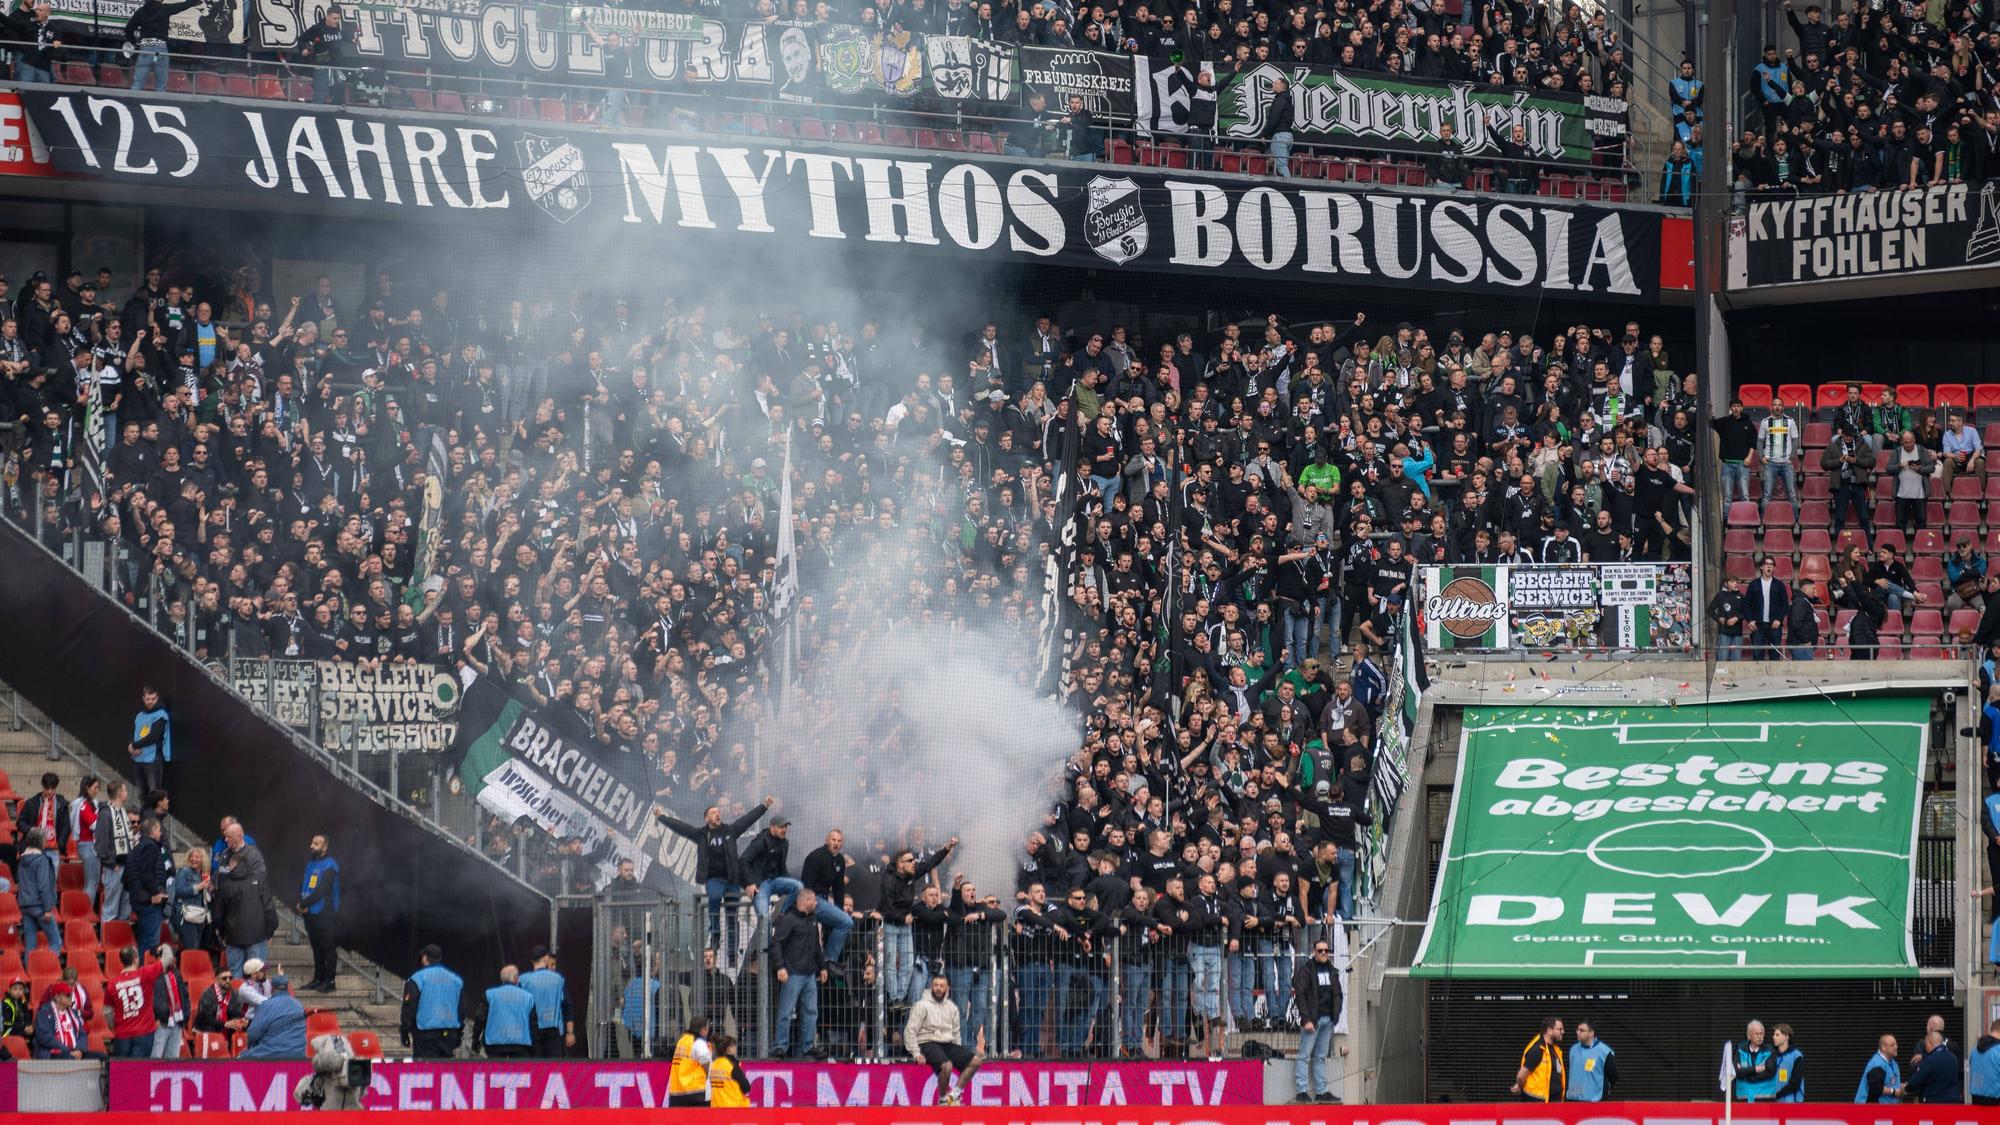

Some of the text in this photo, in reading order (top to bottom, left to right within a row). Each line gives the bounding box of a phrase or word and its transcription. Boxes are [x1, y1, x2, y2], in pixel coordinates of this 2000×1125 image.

[579, 6, 693, 31] TADIONVERBOT
[1023, 69, 1131, 93] FREUNDESKREIS
[1594, 118, 1618, 137] CREW
[526, 148, 581, 196] Borussia
[50, 96, 1643, 296] 125 JAHRE MYTHOS BORUSSIA
[1090, 204, 1135, 237] Borussia
[1749, 183, 1968, 242] KYFFHÄUSER
[1792, 227, 1926, 281] FOHLEN
[1514, 572, 1594, 590] BEGLEIT
[1429, 594, 1507, 621] Ultras
[1514, 590, 1593, 606] SERVICE
[319, 661, 434, 692] BEGLEIT
[320, 691, 437, 721] SERVICE
[510, 717, 643, 831] BRACHELEN
[1495, 755, 1889, 790] Bestens
[499, 767, 568, 826] Willicher
[1489, 789, 1887, 821] abgesichert
[1465, 893, 1882, 930] DEVK
[1513, 934, 1832, 945] Gesagt. Getan. Geholfen.
[118, 986, 144, 1013] 13
[1149, 1070, 1228, 1107] TV
